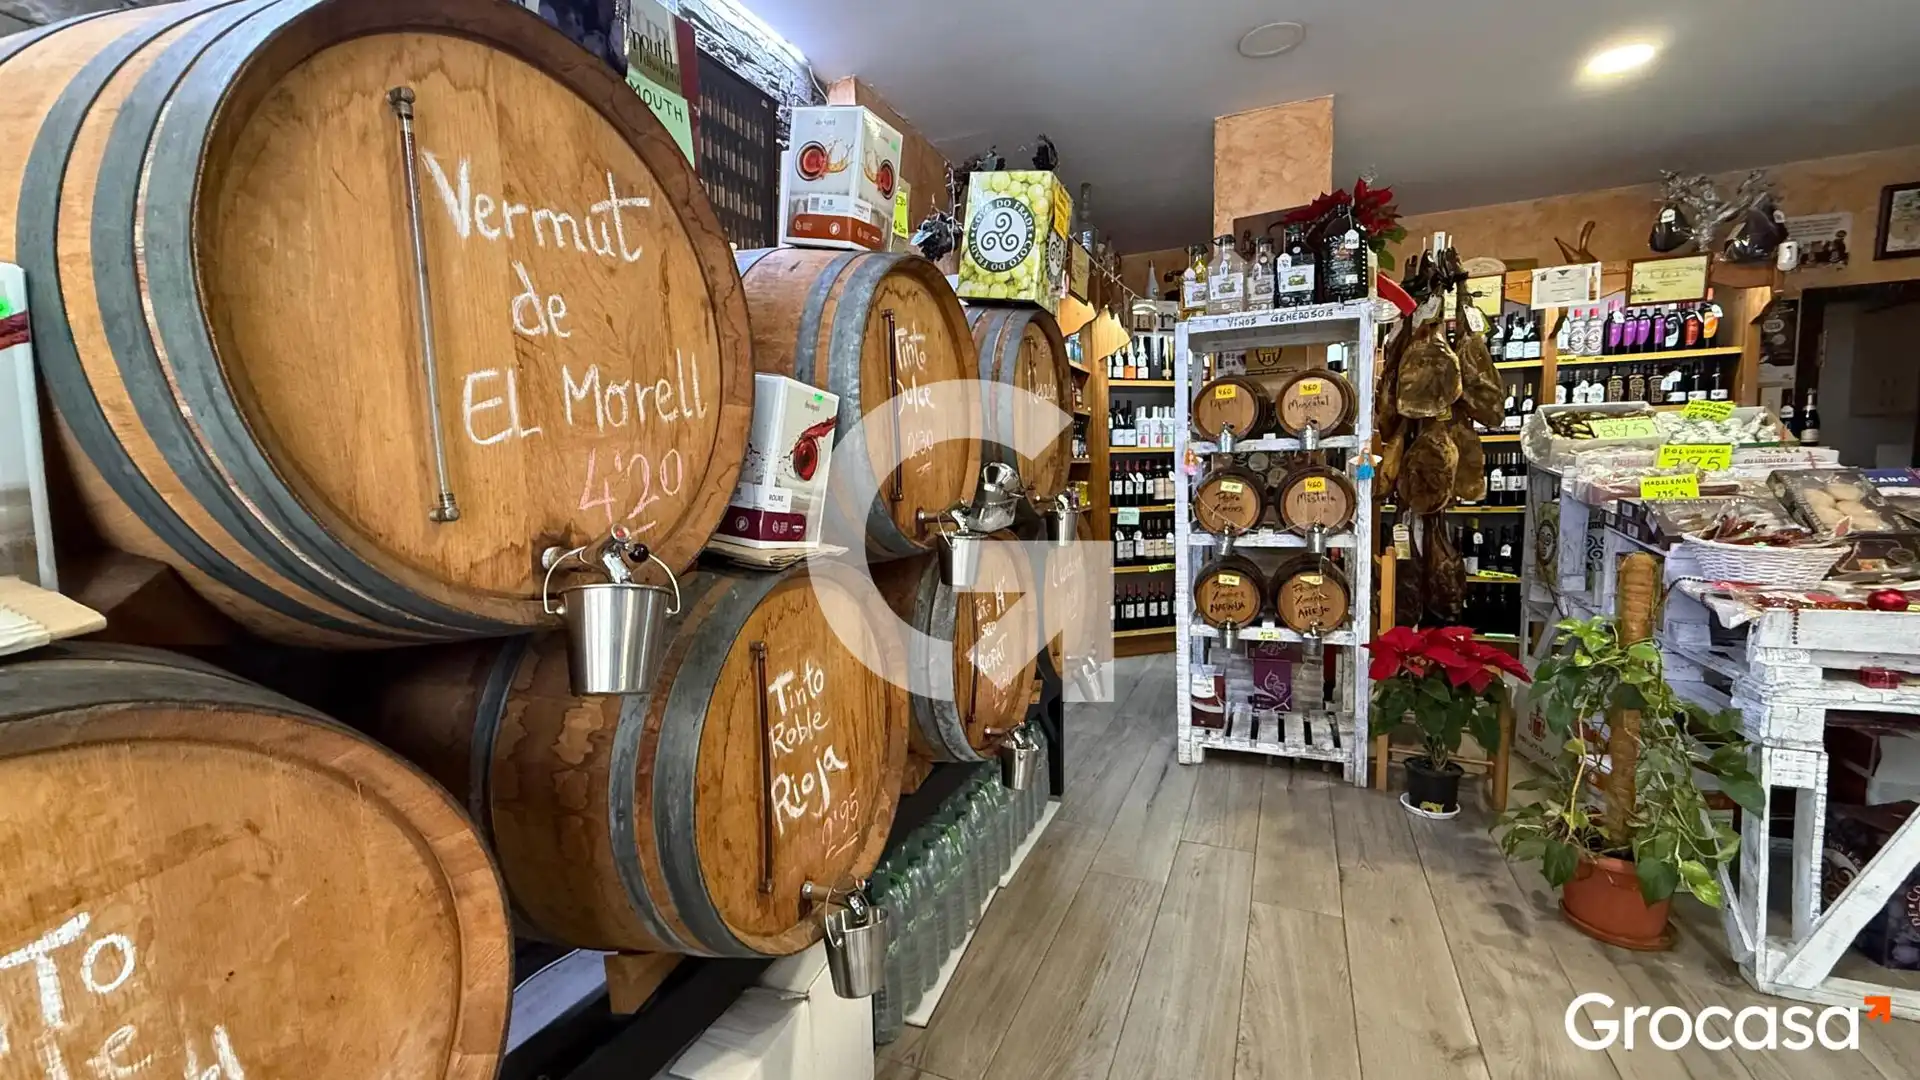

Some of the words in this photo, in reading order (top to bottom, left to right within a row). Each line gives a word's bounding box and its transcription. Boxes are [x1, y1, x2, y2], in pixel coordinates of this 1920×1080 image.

[423, 150, 650, 263] Vermut
[1014, 201, 1034, 232] FRADE
[511, 261, 571, 338] de
[895, 320, 926, 373] Tinto
[461, 368, 543, 444] EL
[562, 349, 707, 433] Morell
[768, 658, 824, 716] Tinto
[769, 708, 831, 758] Roble
[770, 744, 848, 837] Rioja
